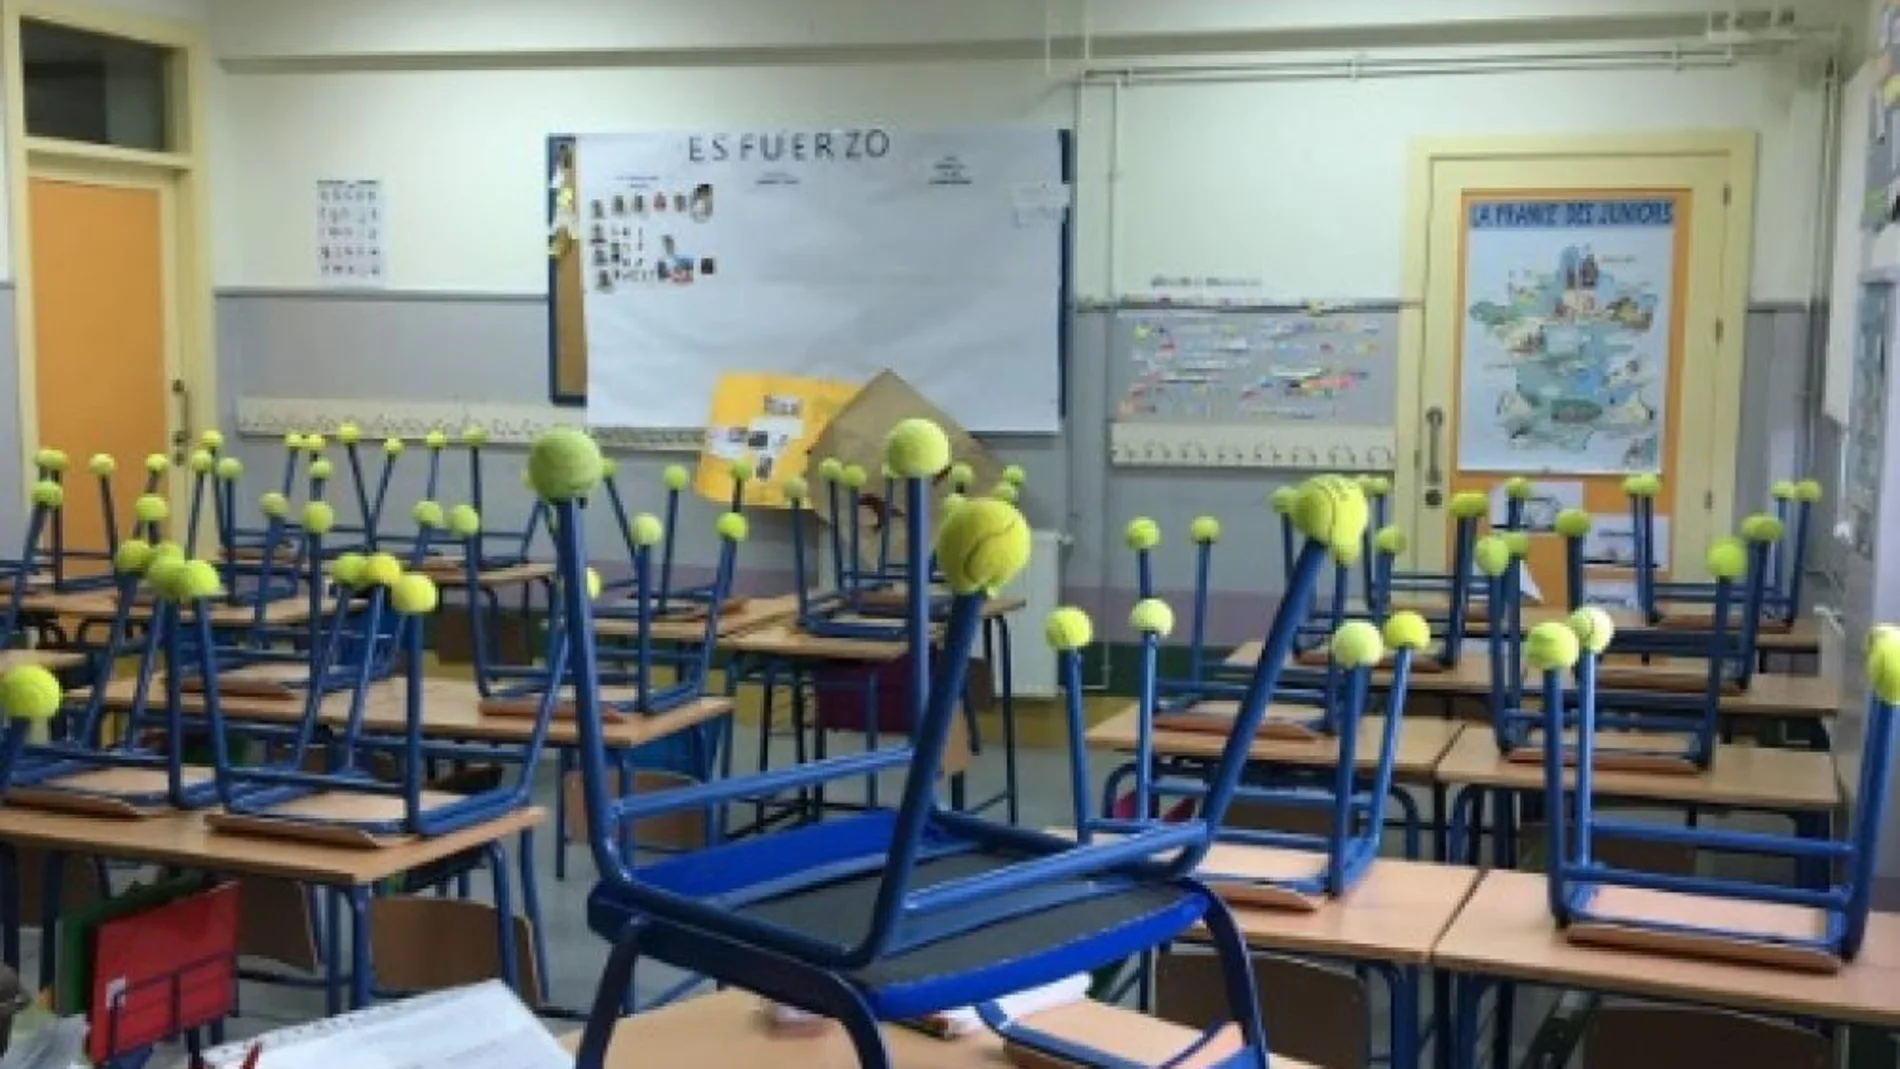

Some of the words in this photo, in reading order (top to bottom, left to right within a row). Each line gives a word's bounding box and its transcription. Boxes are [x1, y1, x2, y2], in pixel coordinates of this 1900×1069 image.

[688, 128, 890, 162] ESFUERZO
[1470, 203, 1492, 227] LA
[1597, 201, 1673, 225] JUNIORS
